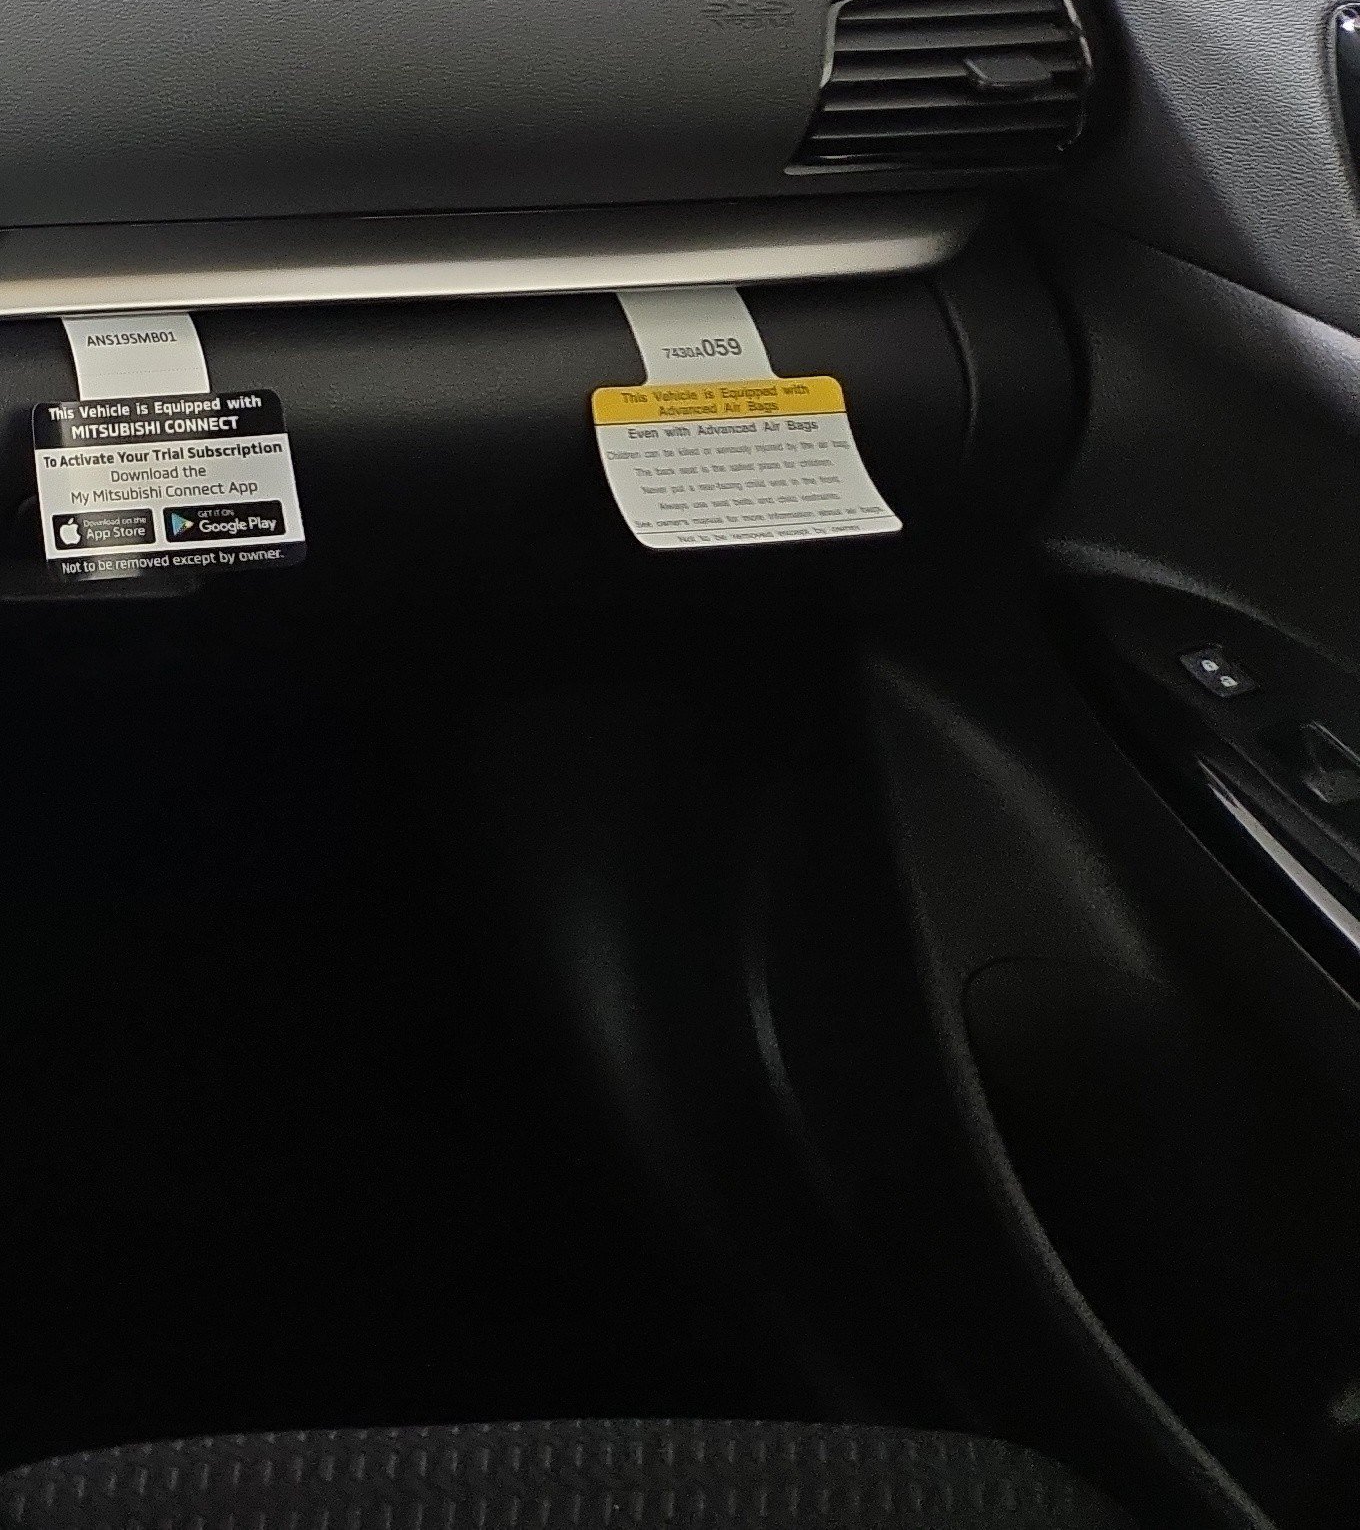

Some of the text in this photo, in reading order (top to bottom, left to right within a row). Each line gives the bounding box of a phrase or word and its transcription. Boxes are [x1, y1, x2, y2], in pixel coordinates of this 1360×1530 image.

[621, 385, 810, 404] This Vehicle is Equipped with
[49, 395, 262, 421] This Vehicle is Equipped with
[658, 404, 718, 416] Advanced
[725, 403, 741, 413] Air
[71, 415, 239, 440] MITSUBISHI CONNECT
[628, 420, 819, 439] Even with Advanced Air Bags
[43, 442, 283, 468] To Activate Your Trial Subscription
[110, 465, 207, 483] Download the
[71, 481, 258, 507] My Mitsubishi Connect App
[86, 526, 146, 541] App Store
[198, 517, 277, 535] Google Play
[61, 549, 284, 574] Not to be removed except by owner.
